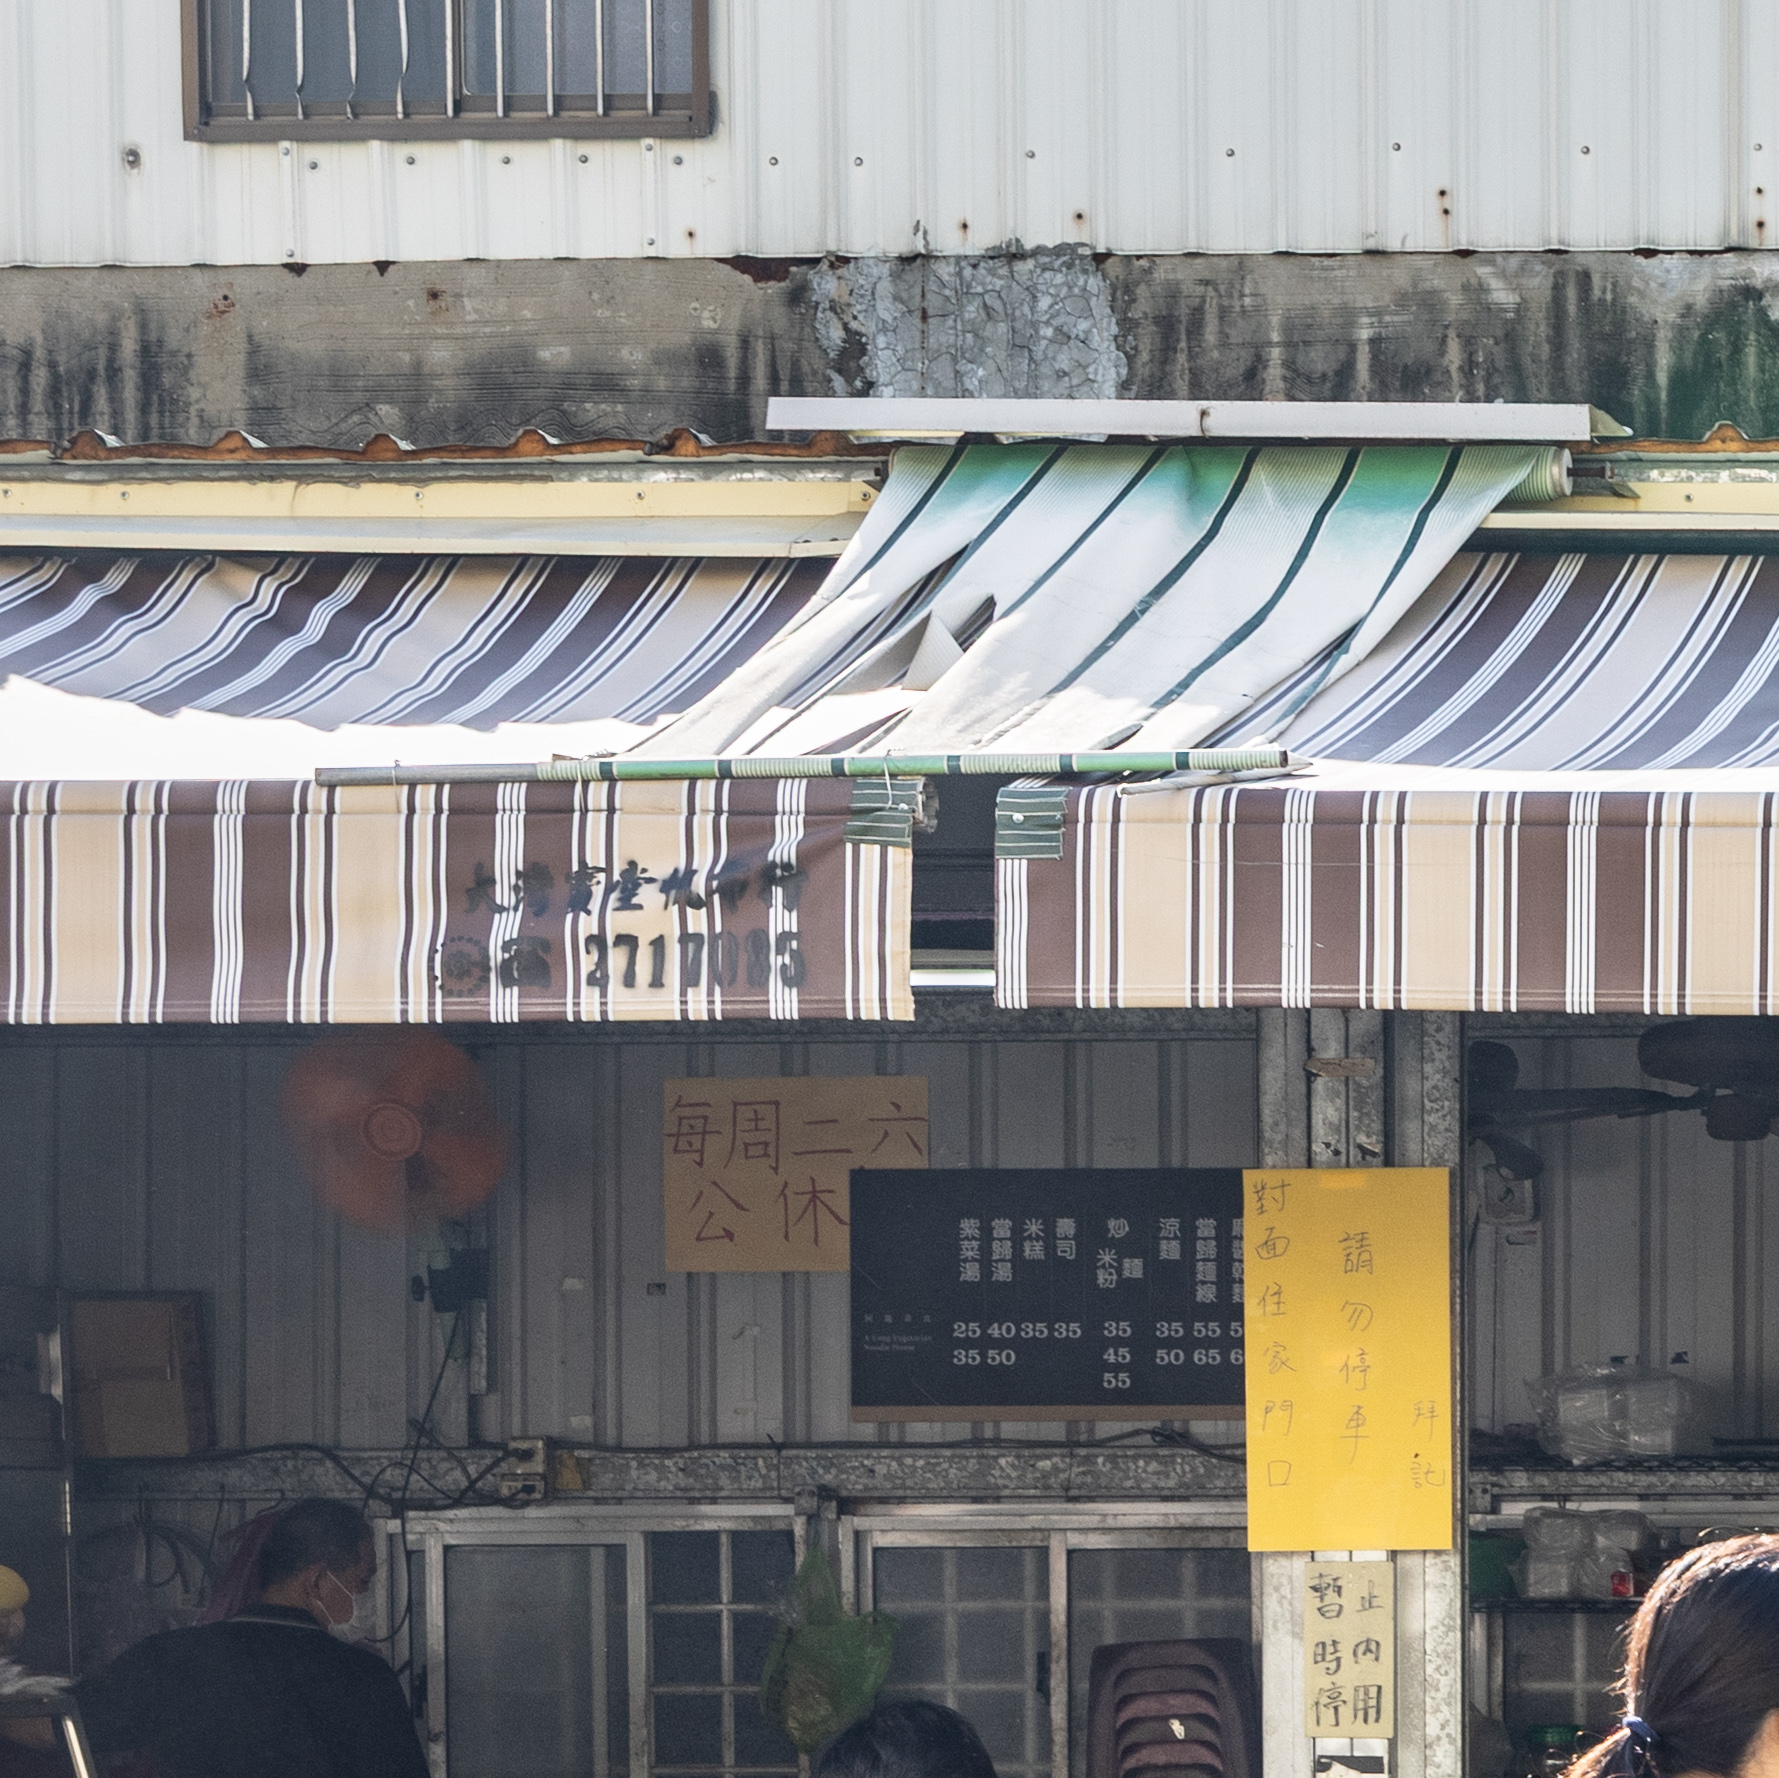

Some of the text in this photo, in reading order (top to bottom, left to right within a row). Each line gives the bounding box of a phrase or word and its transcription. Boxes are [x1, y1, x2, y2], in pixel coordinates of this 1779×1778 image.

[665, 1094, 929, 1176] 每周二六
[688, 1175, 850, 1248] 公休
[960, 1218, 980, 1282] 紫菜湯
[991, 1218, 1012, 1282] 當歸湯
[1023, 1218, 1044, 1260] 米糕
[1055, 1218, 1076, 1260] 壽司
[1159, 1218, 1181, 1260] 涼麵
[1096, 1248, 1118, 1289] 米粉
[1196, 1218, 1217, 1303] 當歸麵線
[953, 1322, 981, 1338] 25
[987, 1322, 1016, 1338] 40
[1020, 1322, 1049, 1338] 35
[1054, 1322, 1082, 1339] 35
[1103, 1321, 1131, 1338] 35
[1156, 1322, 1184, 1338] 35
[1193, 1322, 1221, 1338] 55
[1253, 1178, 1298, 1488] 對面住家門口
[1338, 1230, 1375, 1465] 請勿停車
[953, 1349, 981, 1366] 35
[987, 1349, 1016, 1366] 50
[1103, 1347, 1131, 1364] 45
[1156, 1349, 1185, 1366] 50
[1193, 1349, 1221, 1366] 65
[1103, 1373, 1131, 1389] 55
[1410, 1399, 1446, 1490] 拜託
[1308, 1571, 1348, 1729] 暫時停
[1352, 1579, 1385, 1726] 止內用
